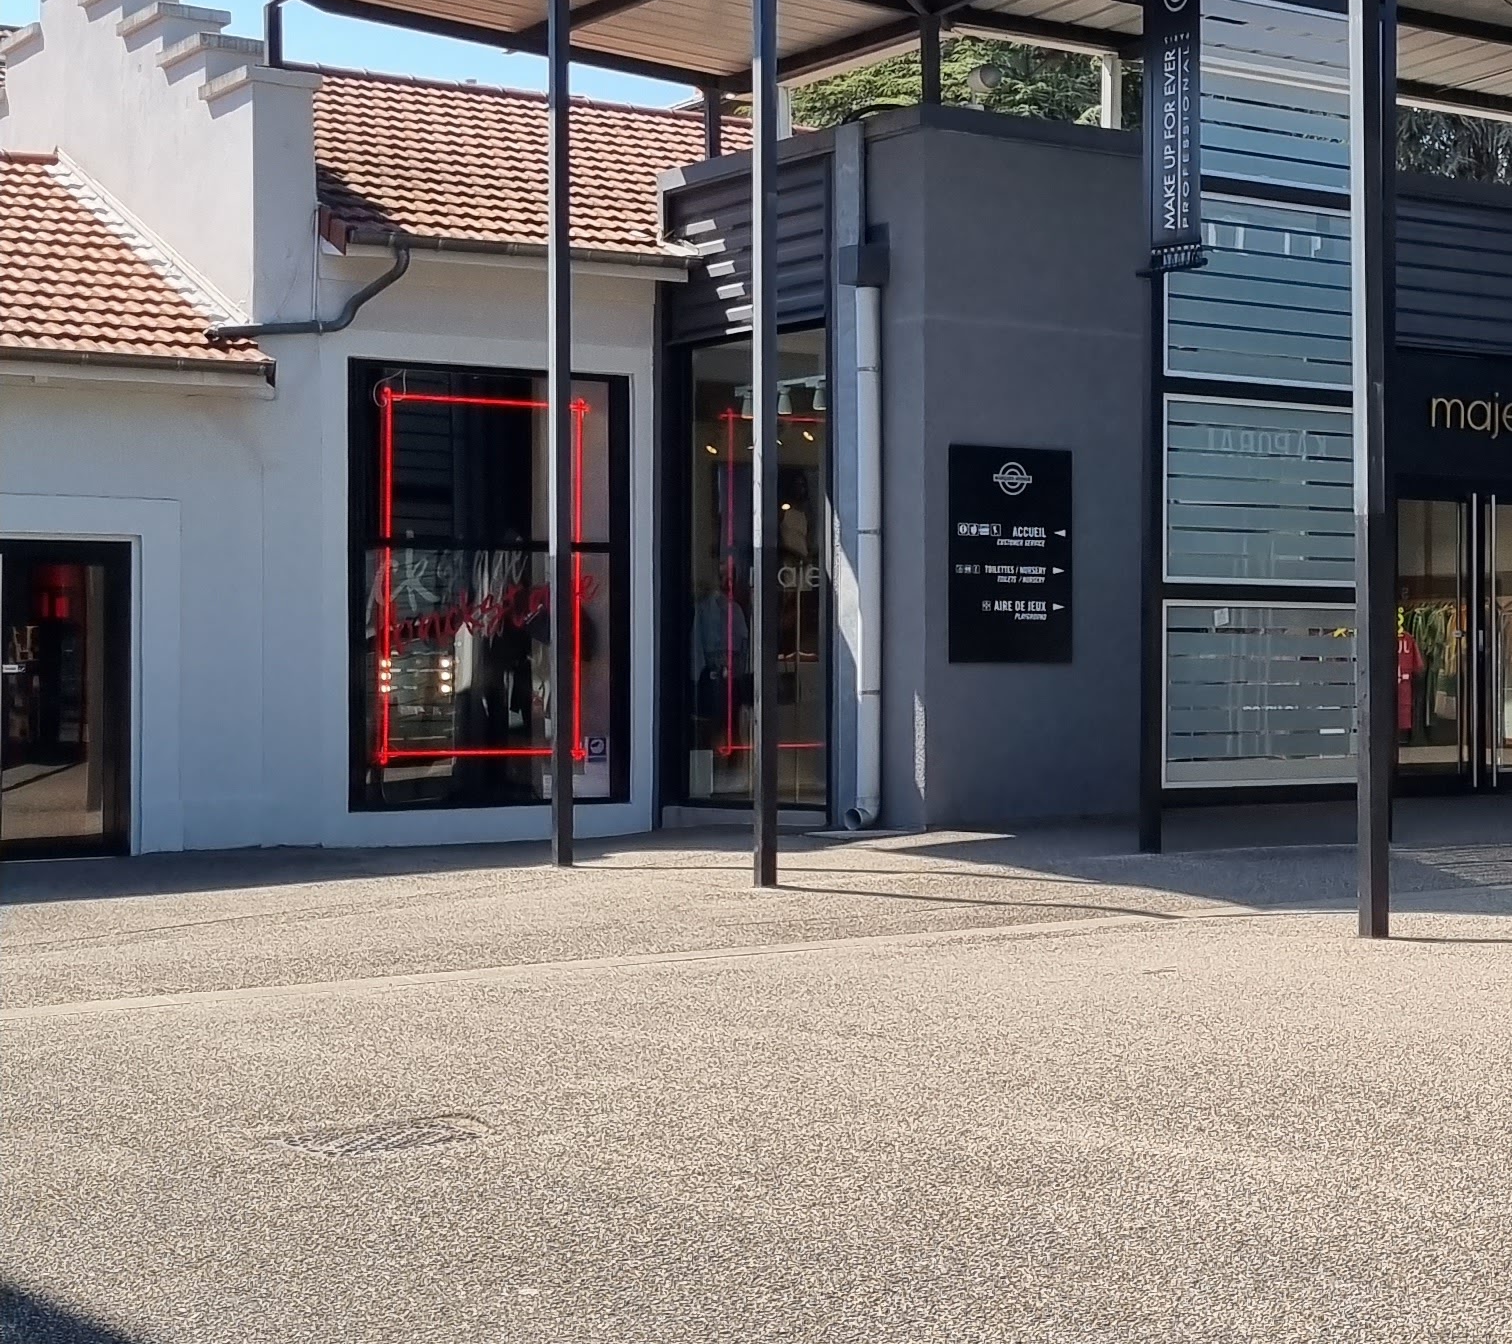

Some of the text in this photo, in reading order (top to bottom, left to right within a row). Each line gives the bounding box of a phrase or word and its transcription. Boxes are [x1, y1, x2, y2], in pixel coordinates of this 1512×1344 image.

[1164, 48, 1176, 230] MAKE UP FOR EVER
[1182, 44, 1190, 229] PROFESSIONAL
[1012, 526, 1047, 538] ACCUEIL
[993, 600, 1047, 612] AIRE DE JEUX
